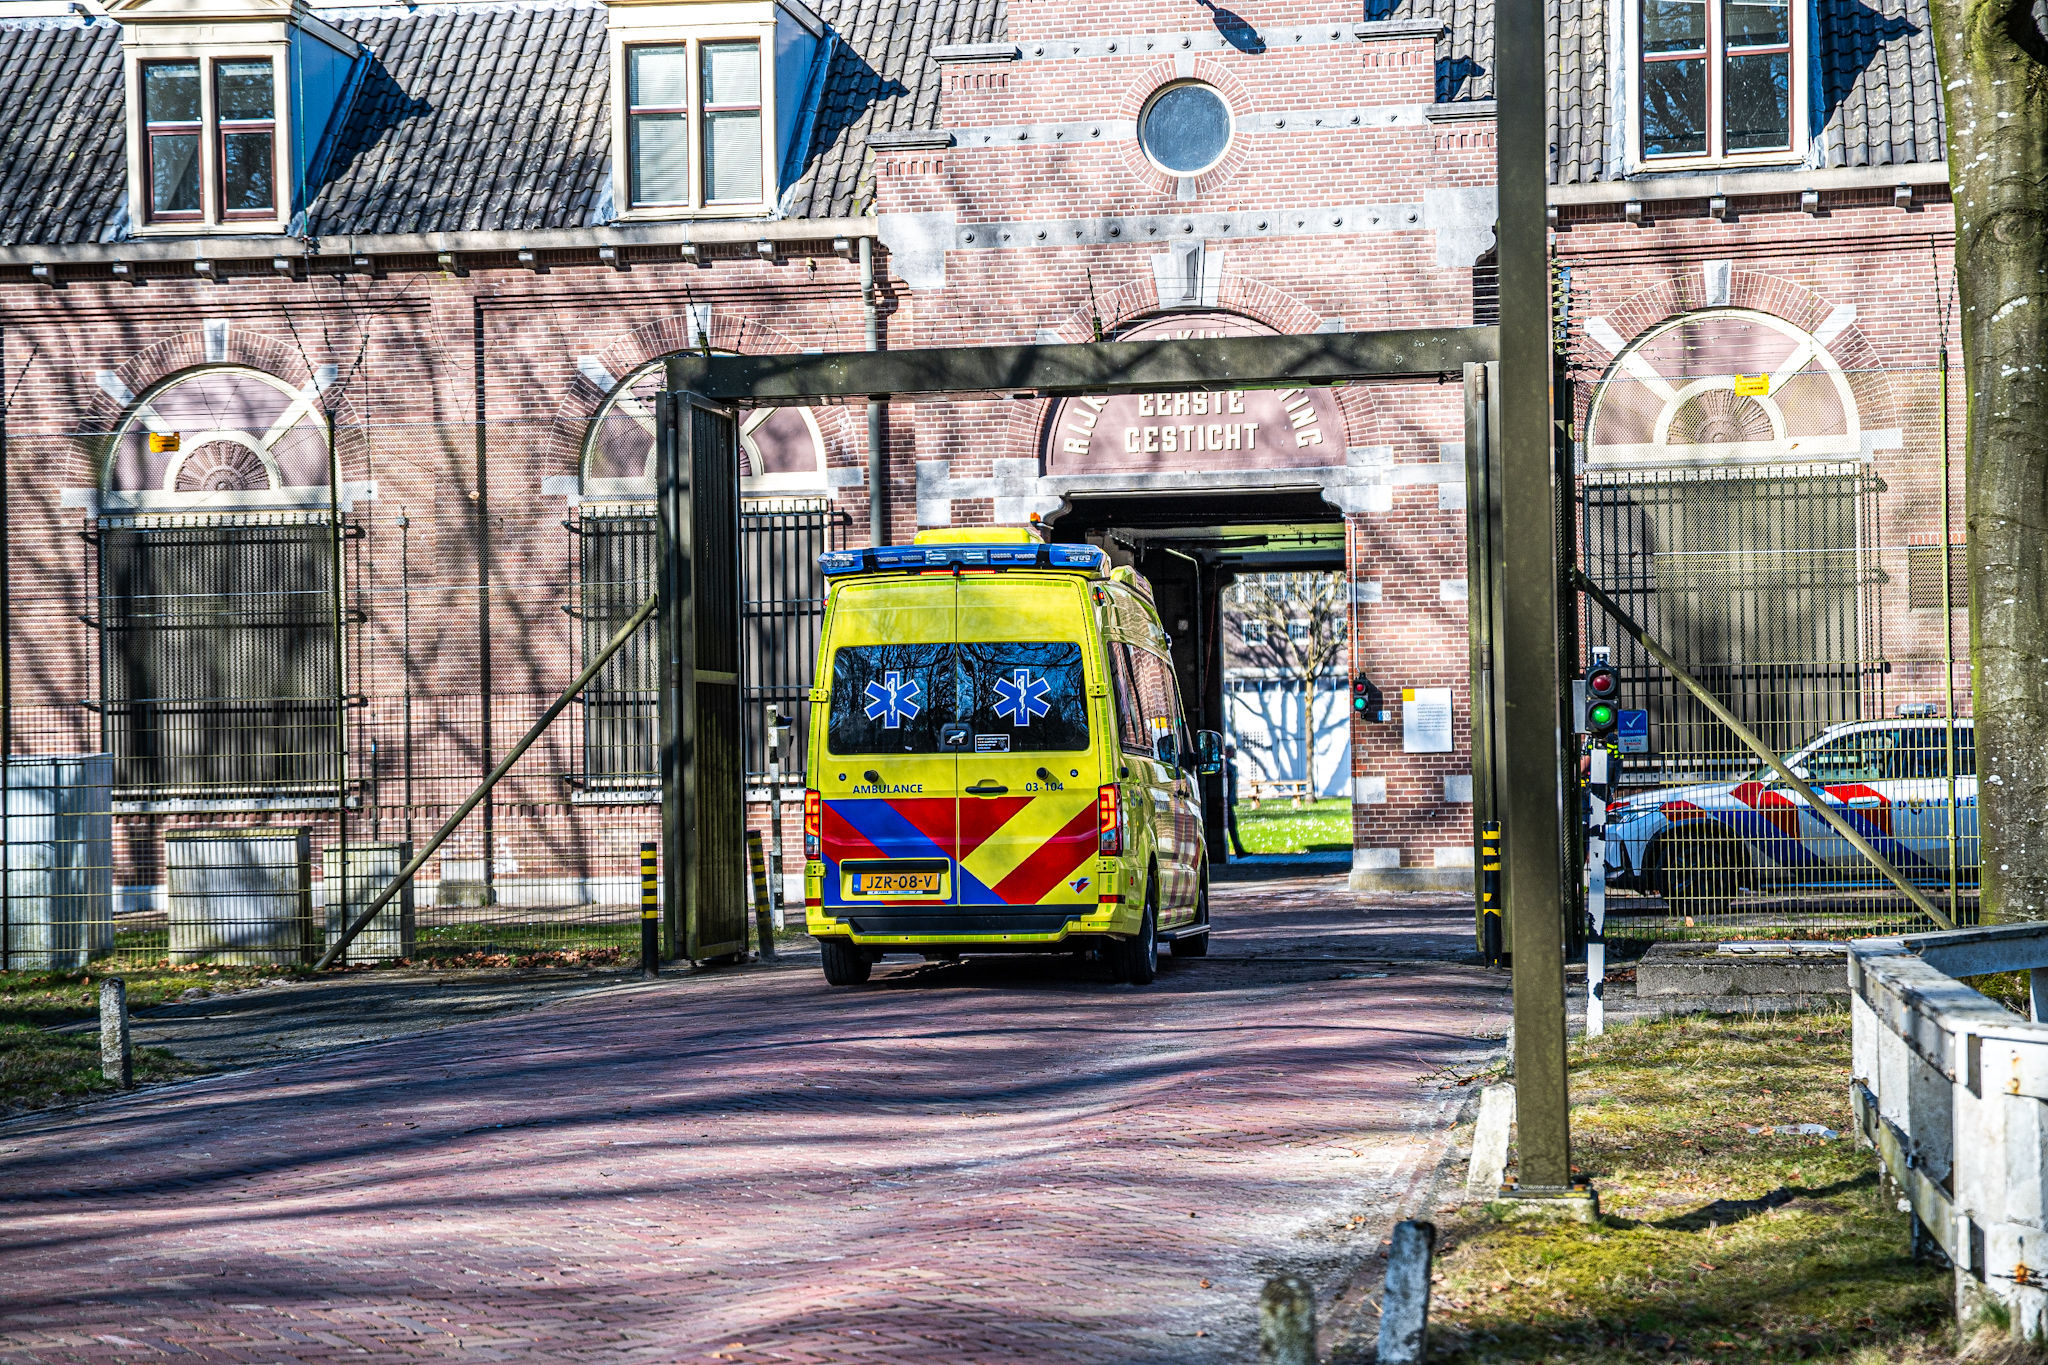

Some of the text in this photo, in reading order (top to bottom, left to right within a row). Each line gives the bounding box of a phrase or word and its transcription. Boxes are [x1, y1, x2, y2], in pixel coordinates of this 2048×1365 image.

[1138, 390, 1245, 417] EERSTE
[1124, 423, 1259, 453] GESTICHT
[852, 784, 923, 794] AMBULANCE
[1025, 782, 1064, 792] 03-104
[866, 875, 932, 889] JZR-08-V
